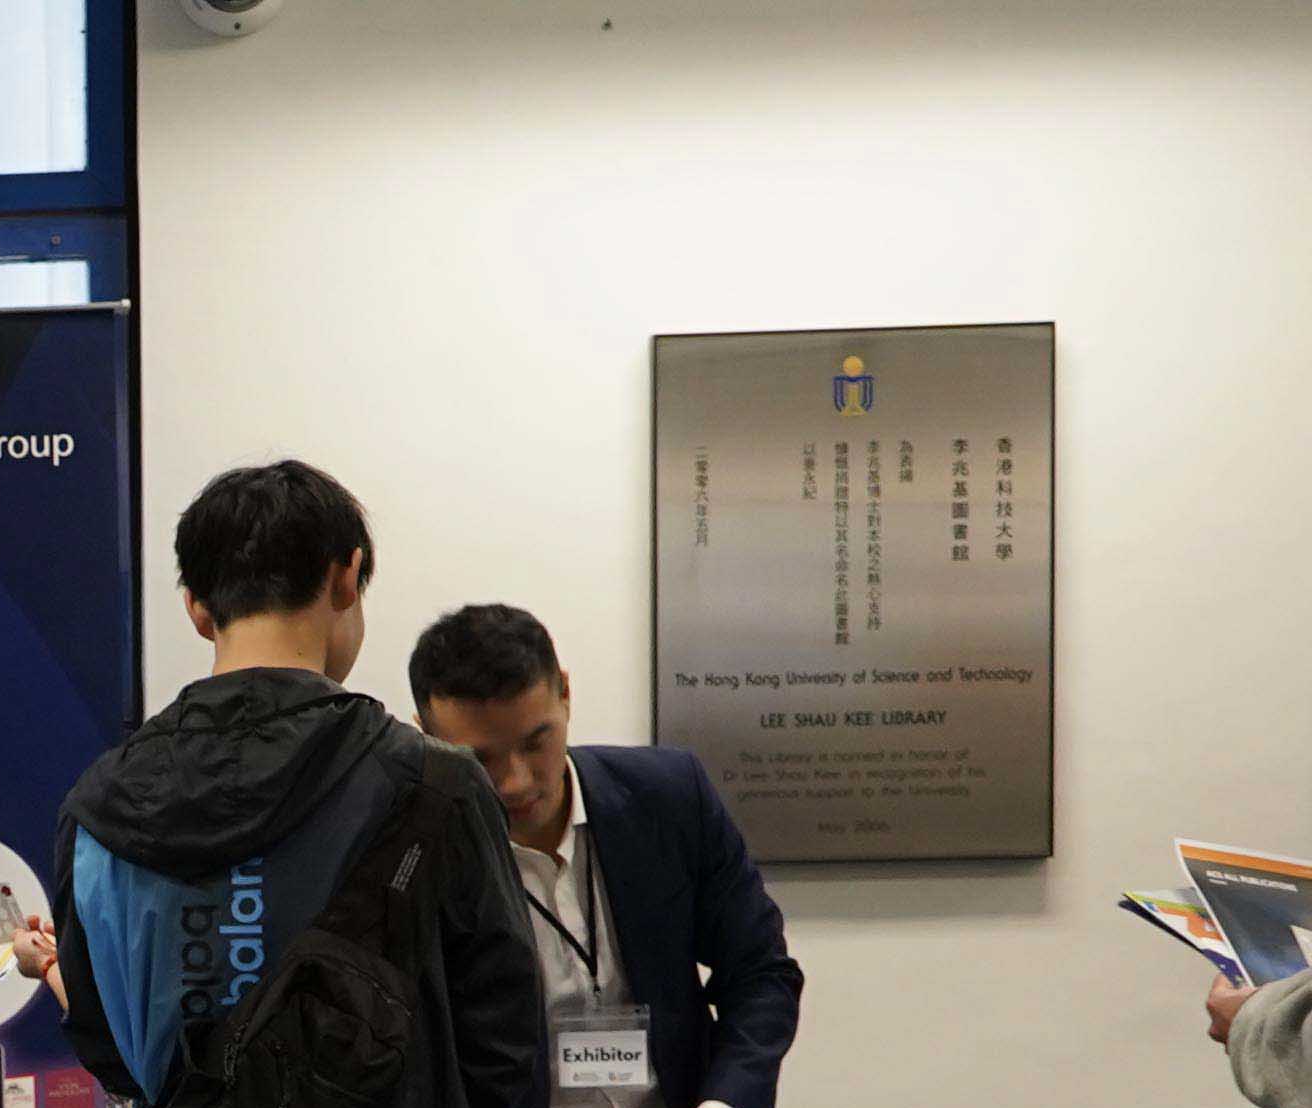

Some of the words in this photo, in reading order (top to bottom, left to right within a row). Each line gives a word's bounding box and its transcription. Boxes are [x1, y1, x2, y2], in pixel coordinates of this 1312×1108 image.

[951, 438, 971, 561] 李兆基圖書館
[995, 436, 1014, 561] 香港科技大學
[676, 672, 698, 687] The
[704, 673, 739, 689] Hong
[745, 673, 780, 689] Kong
[785, 670, 846, 687] University
[852, 670, 866, 684] of
[872, 669, 919, 683] Science
[926, 668, 953, 682] and
[959, 667, 1033, 683] Technology
[760, 714, 785, 728] LEE
[794, 713, 836, 727] SHAU
[845, 712, 873, 726] KEE
[882, 710, 947, 725] LIBRARY
[563, 1046, 642, 1063] Exhibitor
